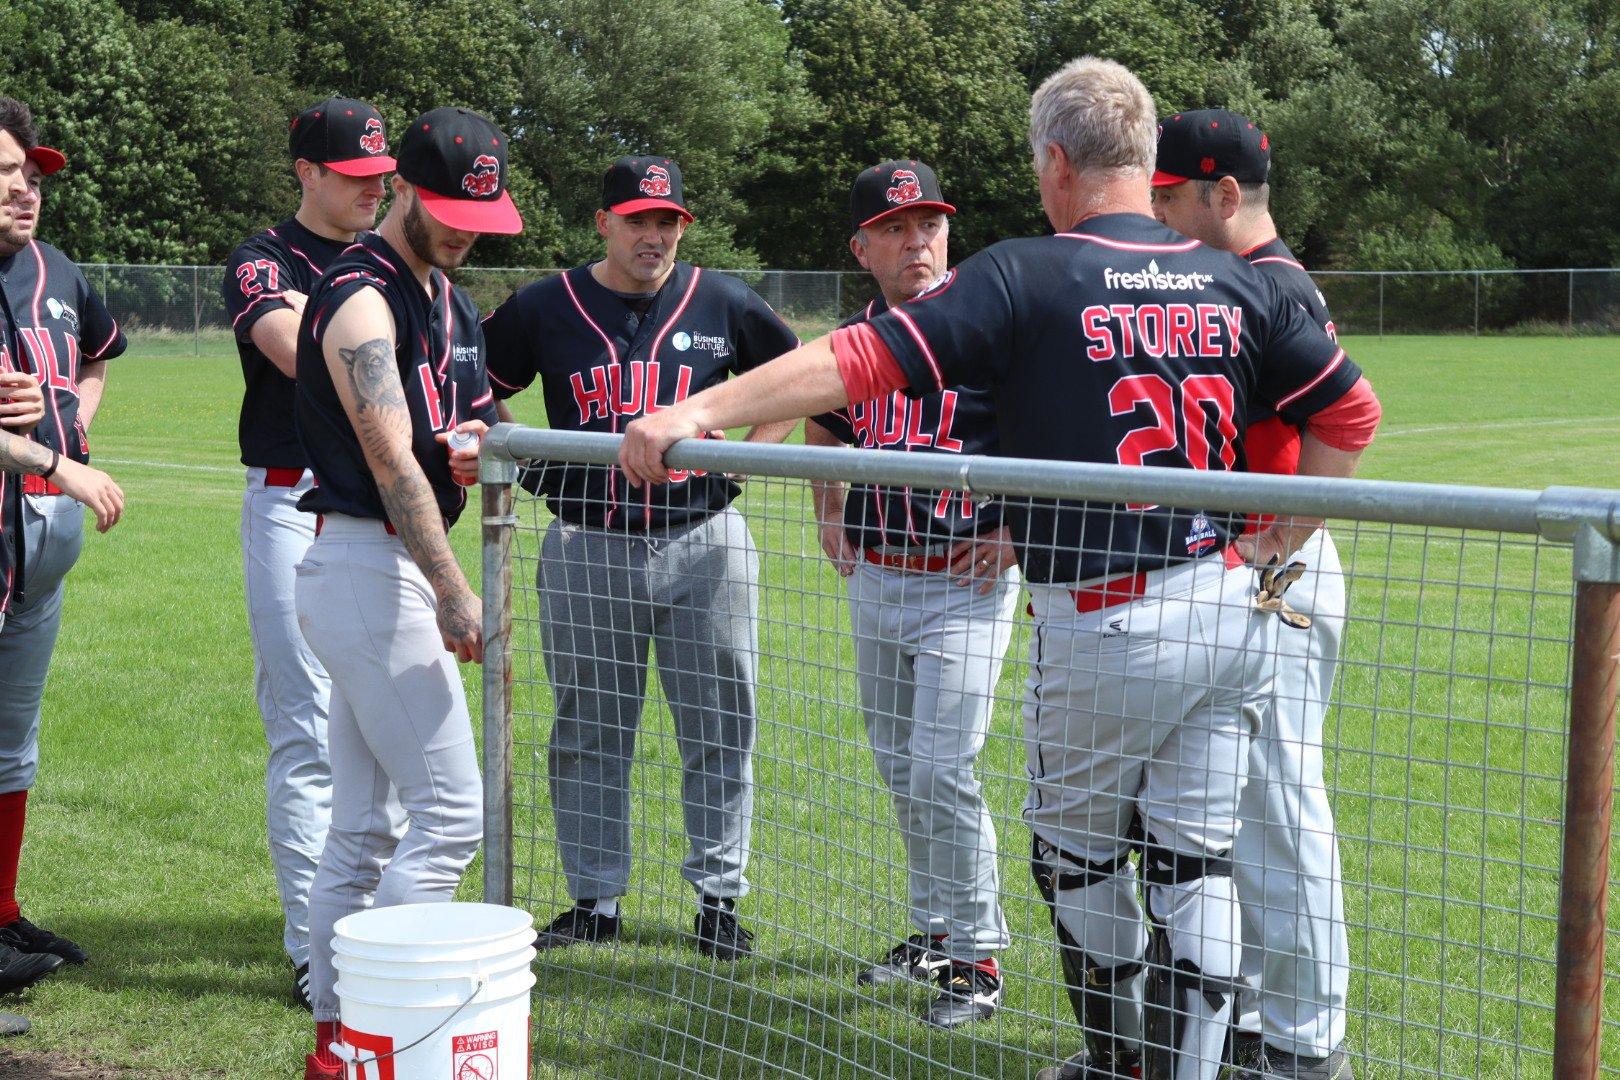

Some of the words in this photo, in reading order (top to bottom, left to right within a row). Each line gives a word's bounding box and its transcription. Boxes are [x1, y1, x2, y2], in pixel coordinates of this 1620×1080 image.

[236, 259, 279, 298] 27
[693, 335, 725, 344] BUSINESS
[693, 341, 725, 352] CULTURE
[1081, 304, 1242, 362] STOREY
[570, 361, 692, 425] HULL
[848, 389, 963, 453] HULL
[1108, 374, 1238, 511] 20
[1185, 529, 1217, 545] BASBALL
[466, 1032, 496, 1044] WARNING
[466, 1041, 494, 1051] AVISO
